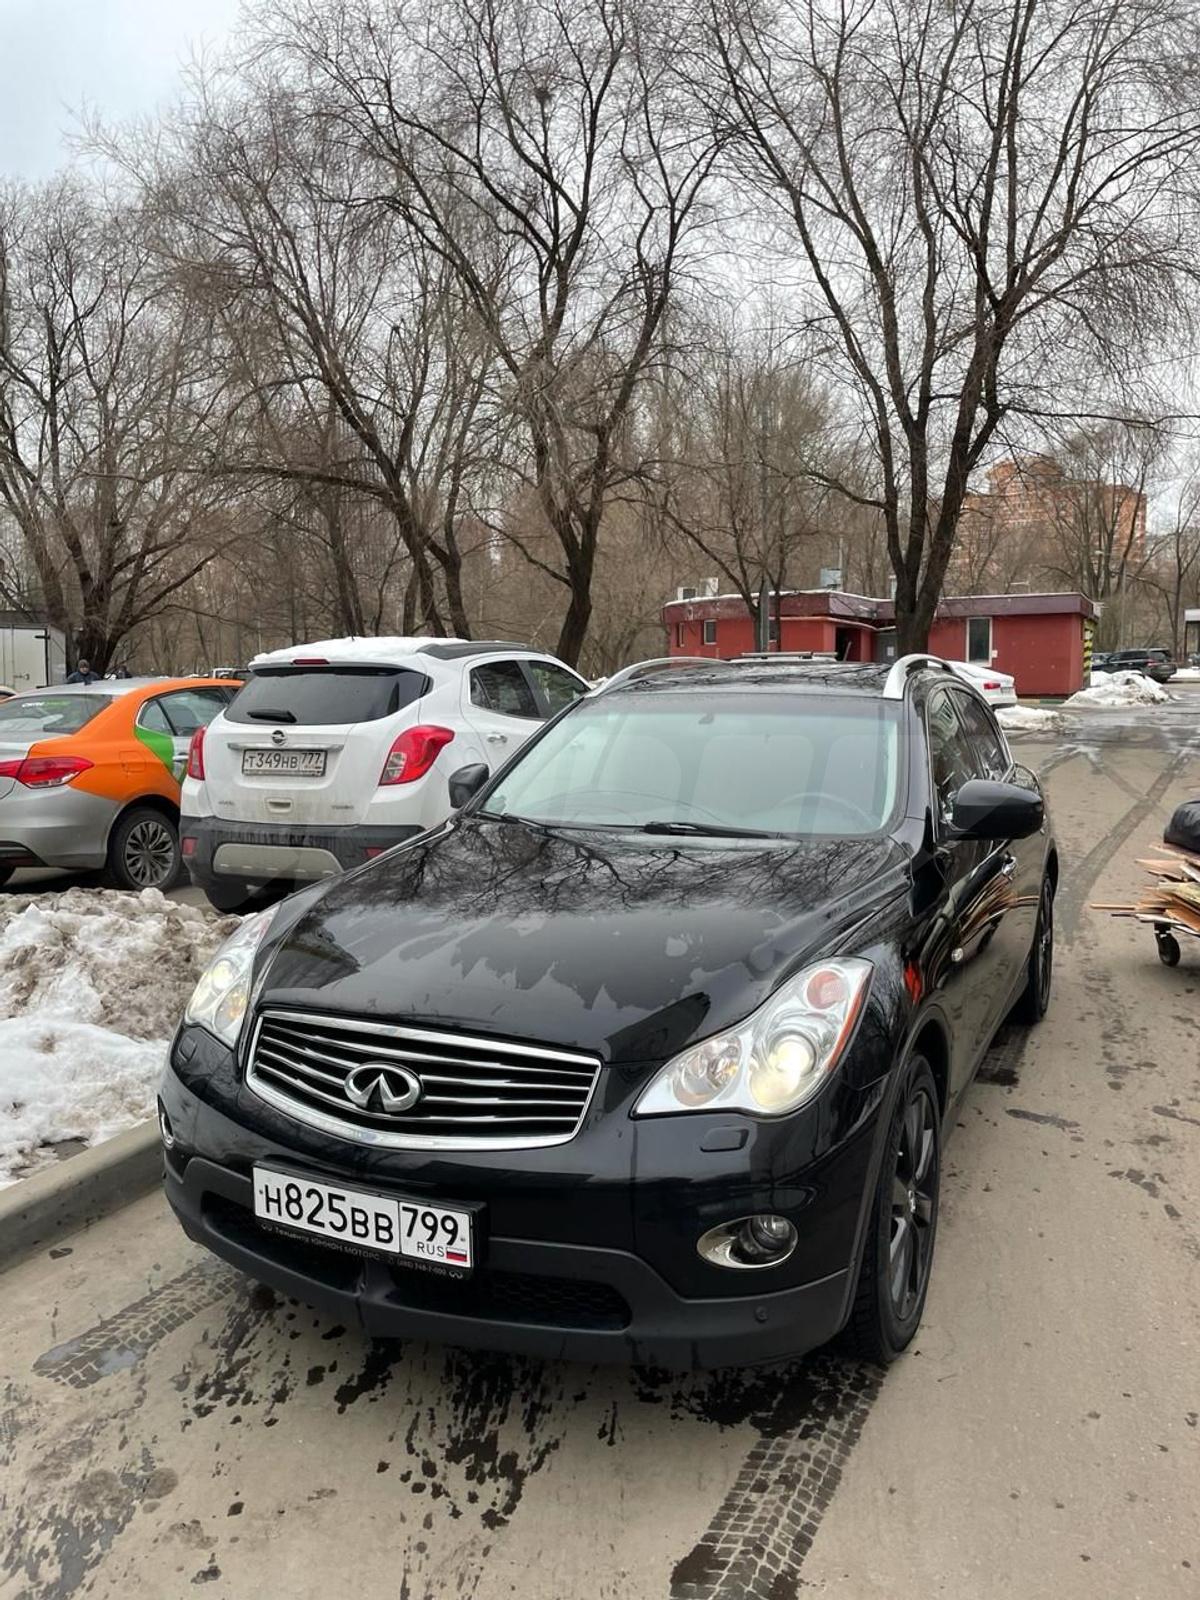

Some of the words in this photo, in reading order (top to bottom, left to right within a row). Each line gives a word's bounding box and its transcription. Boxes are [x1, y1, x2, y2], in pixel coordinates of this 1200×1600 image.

[301, 752, 321, 765] 777
[264, 1182, 394, 1244] Н825ВВ
[402, 1206, 459, 1246] 799
[416, 1241, 445, 1258] RUS
